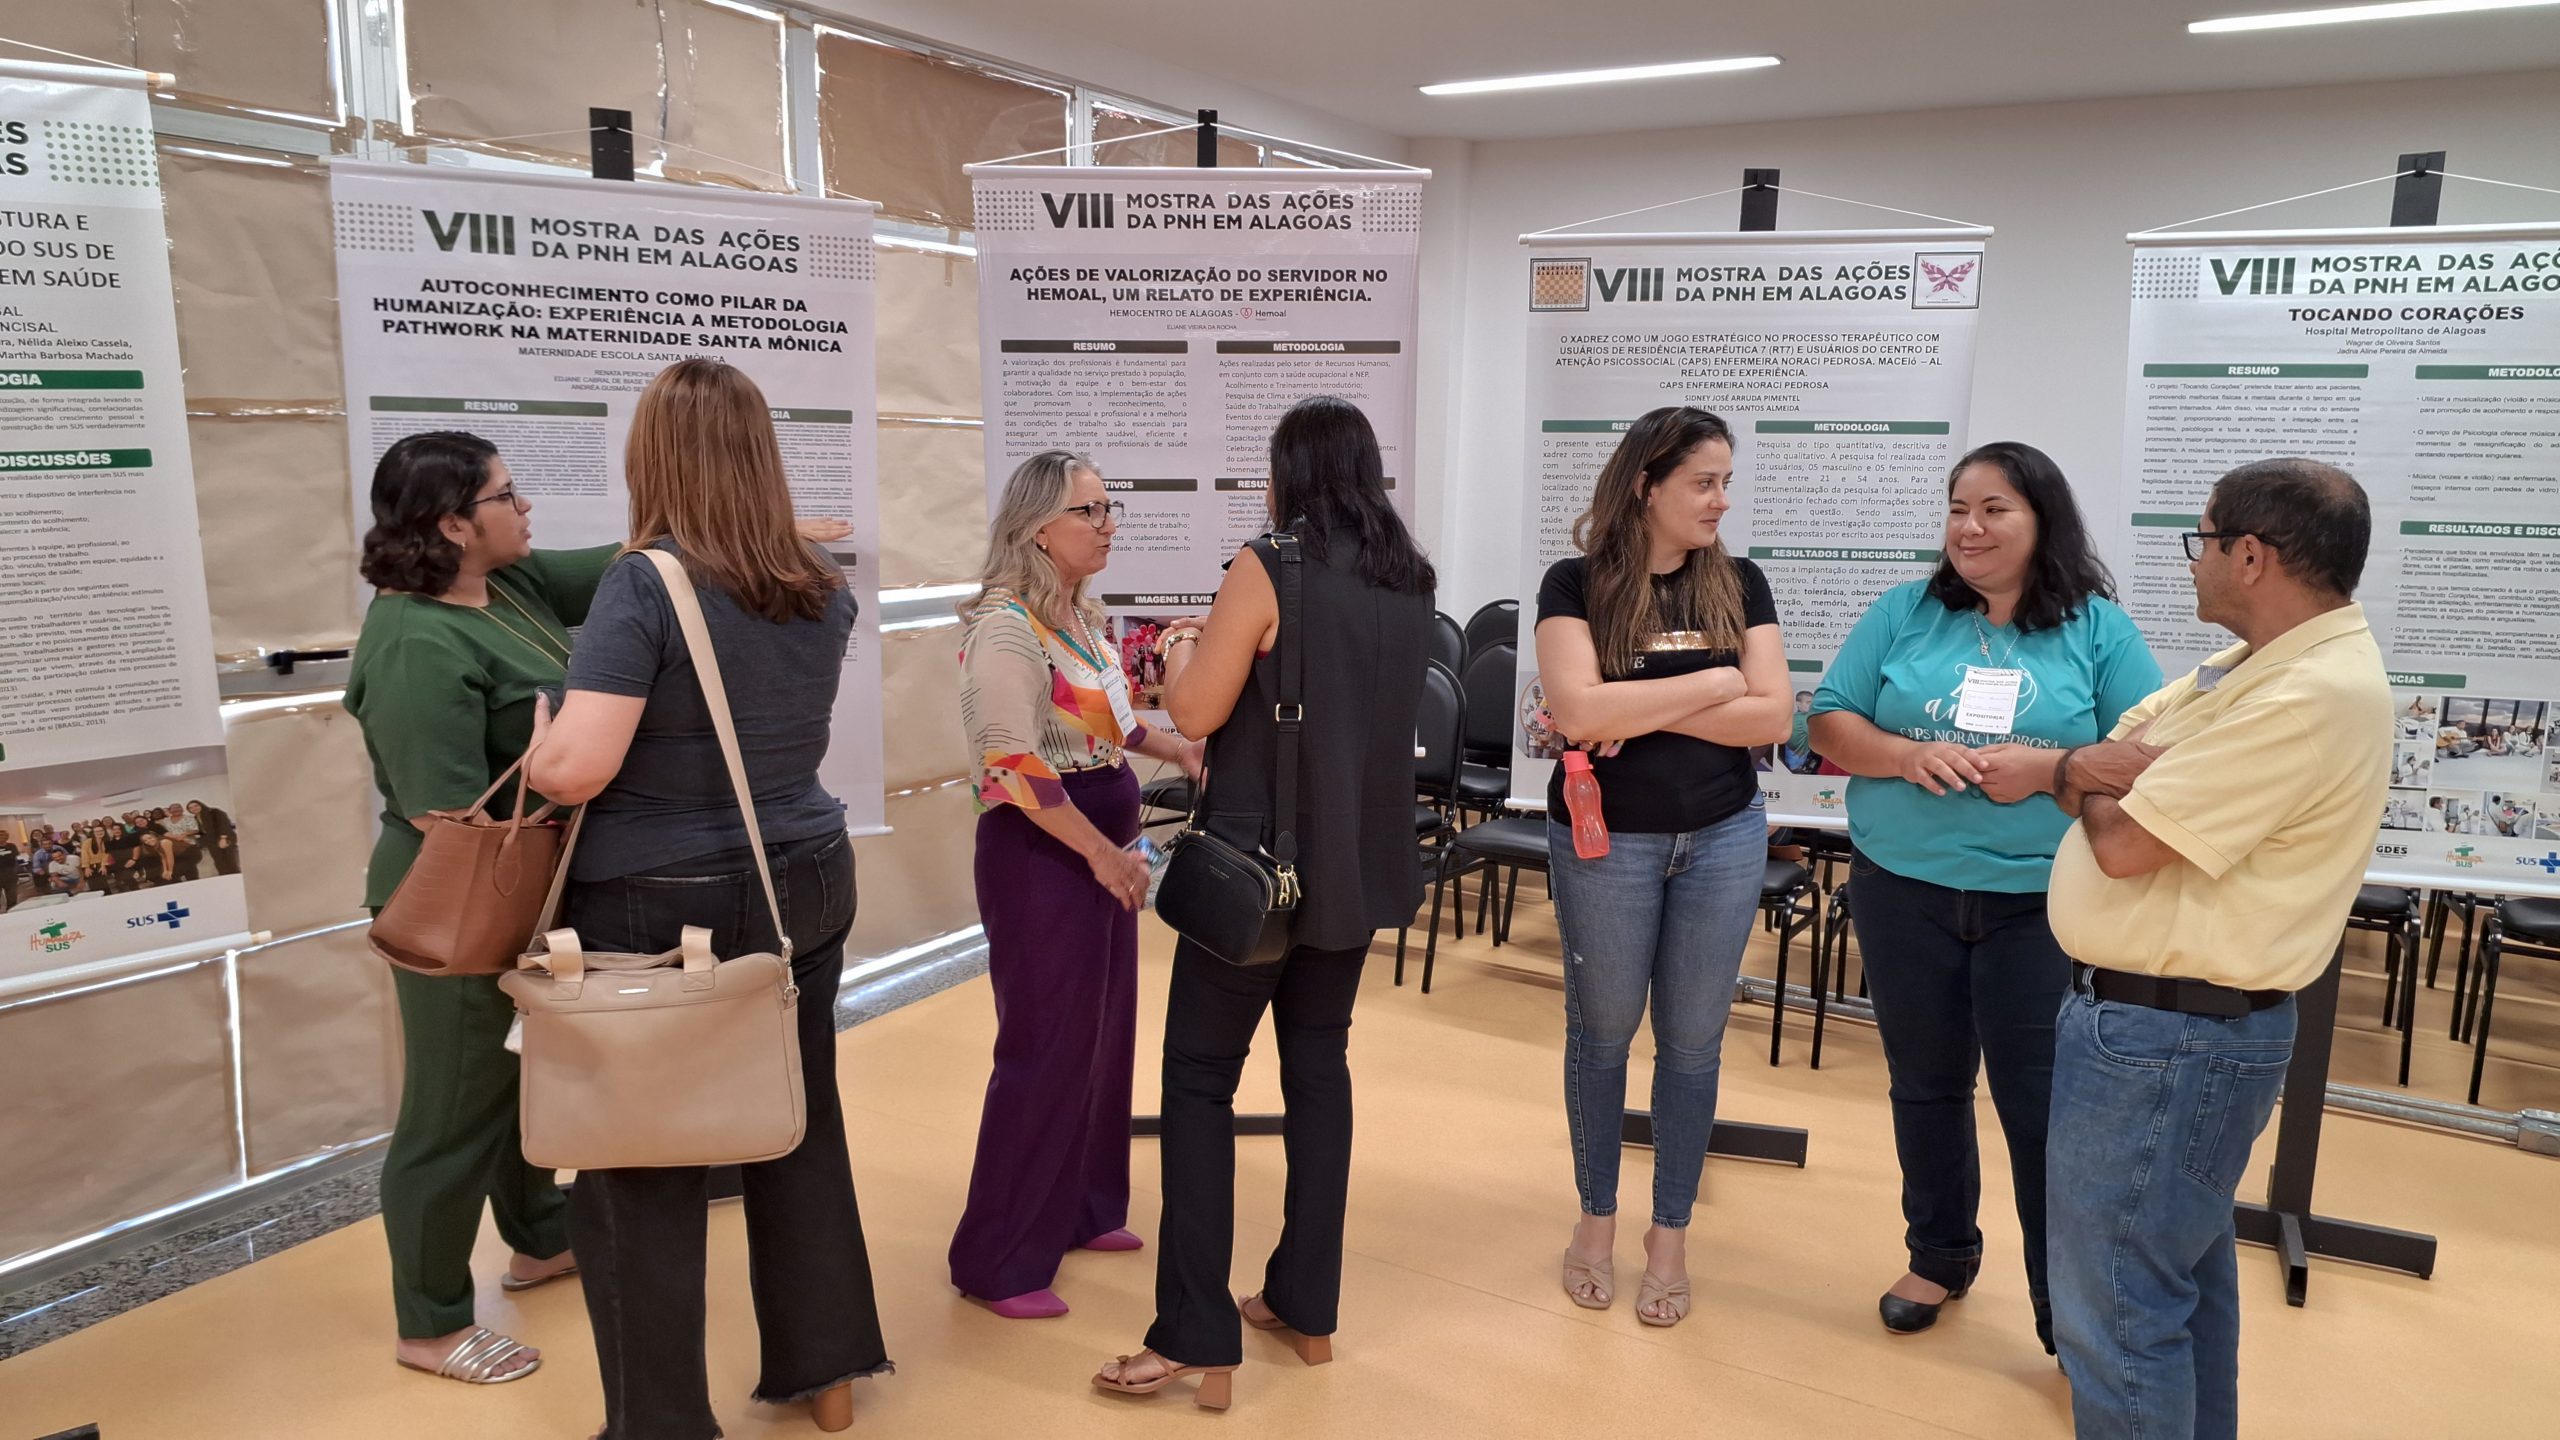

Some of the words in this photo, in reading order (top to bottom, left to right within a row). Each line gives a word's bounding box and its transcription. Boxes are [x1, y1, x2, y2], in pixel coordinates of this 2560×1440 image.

[1041, 192, 1114, 228] VIII
[1126, 193, 1215, 208] MOSTRA
[1227, 193, 1270, 209] DAS
[1282, 190, 1354, 212] AÇÕES
[76, 214, 88, 230] E
[1126, 213, 1157, 229] DA
[1163, 214, 1206, 229] PNH
[1213, 214, 1242, 229] EM
[1248, 214, 1351, 229] ALAGOAS
[422, 209, 515, 255] VIII
[530, 217, 640, 240] MOSTRA
[654, 225, 704, 245] DAS
[718, 226, 800, 256] AÇÕES
[33, 240, 78, 258] SUS
[85, 243, 115, 260] DE
[531, 240, 569, 259] DA
[577, 243, 628, 262] PNH
[637, 247, 672, 265] EM
[680, 250, 798, 273] ALAGOAS
[42, 266, 120, 288] SAÚDE
[1009, 265, 1070, 284] AÇÕES
[1076, 268, 1099, 281] DE
[1104, 266, 1231, 285] VALORIZAÇÃO
[1237, 269, 1261, 282] DO
[1267, 269, 1357, 282] SERVIDOR
[1362, 269, 1387, 282] NO
[1593, 268, 1664, 302] VIII
[1676, 266, 1766, 282] MOSTRA
[1778, 265, 1822, 281] DAS
[1834, 260, 1910, 283] AÇÕES
[2210, 257, 2295, 295] VIII
[2310, 254, 2421, 272] MOSTRA
[2437, 253, 2494, 270] DAS
[2308, 278, 2345, 294] DA
[2353, 277, 2408, 294] PNH
[2416, 276, 2454, 292] EM
[2461, 274, 2560, 292] ALAGO
[420, 278, 649, 304] AUTOCONHECIMENTO
[655, 291, 714, 307] COMO
[720, 294, 777, 310] PILAR
[782, 298, 807, 312] DA
[1026, 287, 1106, 303] HEMOAL,
[1112, 288, 1139, 301] UM
[1146, 288, 1214, 301] RELATO
[1220, 288, 1243, 301] DE
[1248, 286, 1371, 301] EXPERIÊNCIA.
[1675, 286, 1705, 301] DA
[1712, 286, 1755, 301] PNH
[1762, 286, 1792, 301] EM
[1798, 284, 1906, 301] ALAGOAS
[373, 295, 542, 321] HUMANIZAÇÃO:
[548, 303, 685, 325] EXPERIÊNCIA
[691, 313, 704, 326] A
[710, 314, 848, 334] METODOLOGIA
[1109, 309, 1173, 317] HEMOCENTRO
[1175, 309, 1187, 317] DE
[1189, 309, 1233, 317] ALAGOAS
[1255, 309, 1286, 317] Hemoal
[2288, 307, 2392, 321] TOCANDO
[2400, 304, 2524, 323] CORAÇÕES
[382, 319, 504, 337] PATHWORK
[510, 324, 540, 339] NA
[546, 326, 692, 346] MATERNIDADE
[698, 333, 762, 349] SANTA
[767, 334, 842, 352] MÔNICA
[1560, 335, 1568, 343] O
[1570, 334, 1609, 343] XADREZ
[1611, 334, 1641, 342] COMO
[1643, 334, 1658, 342] UM
[1660, 334, 1689, 342] JOGO
[1691, 331, 1762, 345] ESTRATÉGICO
[1764, 333, 1779, 342] NO
[1781, 333, 1838, 344] PROCESSO
[1840, 331, 1913, 342] TERAPÊUTICO
[1915, 333, 1939, 342] COM
[2305, 326, 2348, 336] Hospital
[2350, 326, 2424, 336] Metropolitano
[2426, 326, 2440, 334] de
[2441, 326, 2486, 336] Alagoas
[17, 337, 53, 346] Nélida
[55, 338, 88, 346] Aleixo
[90, 338, 132, 348] Cassela,
[1072, 342, 1116, 350] RESUMO
[1272, 342, 1345, 351] METODOLOGIA
[1559, 344, 1609, 354] USUÁRIOS
[1611, 346, 1625, 354] DE
[1627, 344, 1686, 354] RESIDÊNCIA
[1688, 343, 1758, 354] TERAPÊUTICA
[1760, 345, 1766, 353] 7
[1768, 345, 1794, 355] (RT7)
[1796, 345, 1803, 353] E
[1806, 343, 1859, 353] USUÁRIOS
[1861, 345, 1877, 353] DO
[1879, 345, 1922, 353] CENTRO
[1924, 345, 1939, 353] DE
[2345, 339, 2373, 347] Wagner
[2374, 339, 2384, 348] de
[39, 351, 83, 359] Barbosa
[84, 351, 134, 360] Machado
[518, 348, 598, 358] MATERNIDADE
[601, 350, 644, 360] ESCOLA
[648, 352, 682, 362] SANTA
[1010, 358, 1049, 367] valorização
[1052, 358, 1065, 366] dos
[1068, 358, 1112, 367] profissionais
[1555, 356, 1601, 367] ATENÇÃO
[1603, 357, 1675, 365] PSICOSSOCIAL
[1677, 357, 1711, 367] (CAPS)
[1713, 357, 1779, 369] ENFERMEIRA
[1780, 356, 1820, 365] NORACI
[1822, 356, 1875, 365] PEDROSA.
[1928, 357, 1942, 365] AL
[1680, 368, 1719, 376] RELATO
[1722, 368, 1736, 376] DE
[1738, 366, 1807, 376] EXPERIÊNCIA.
[2227, 366, 2280, 374] RESUMO
[1784, 381, 1829, 389] PEDROSA
[1711, 393, 1729, 401] JOSÉ
[463, 400, 519, 415] RESUMO
[1814, 422, 1890, 431] METODOLOGIA
[2428, 523, 2511, 536] RESULTADOS
[2513, 526, 2523, 535] E
[1771, 549, 1839, 560] RESULTADOS
[1841, 550, 1848, 558] E
[1850, 549, 1916, 559] DISCUSSÕES
[1935, 729, 1990, 745] NORACI
[2515, 856, 2537, 866] SUS
[126, 914, 155, 928] SUS
[46, 942, 70, 952] SUS
